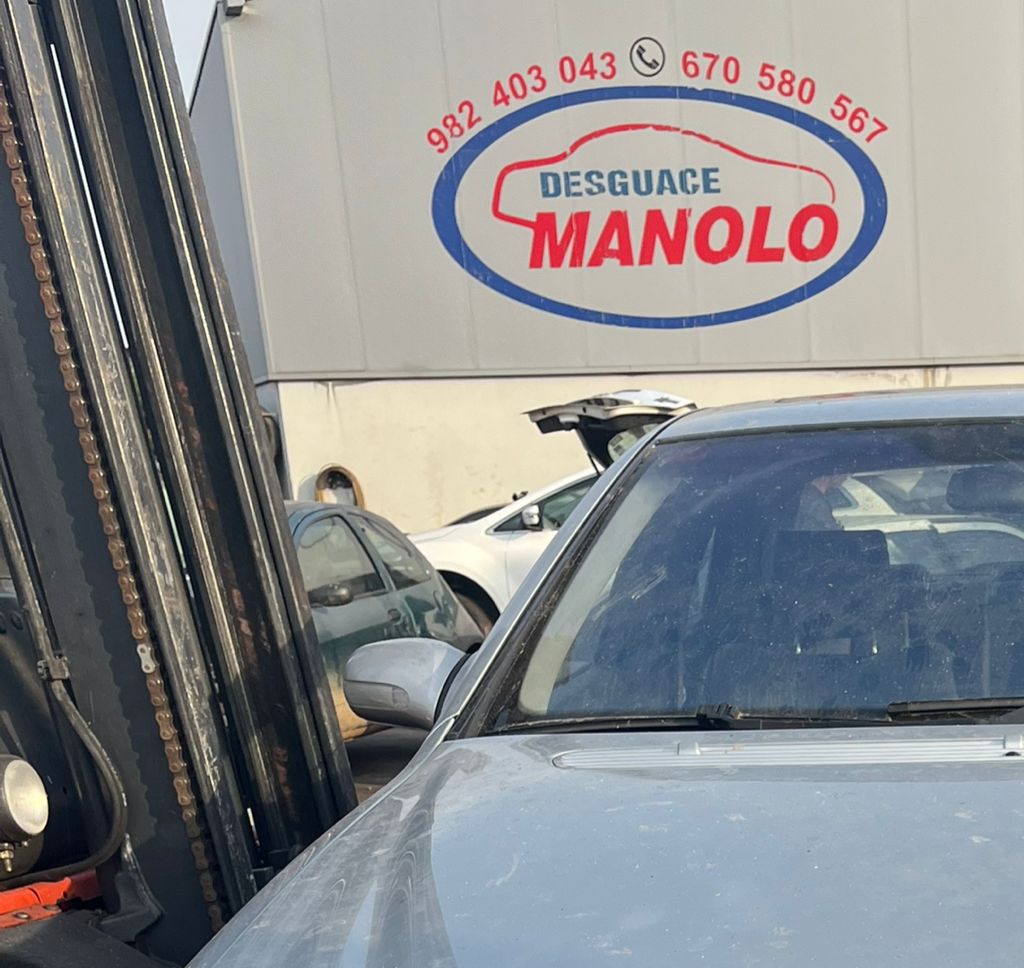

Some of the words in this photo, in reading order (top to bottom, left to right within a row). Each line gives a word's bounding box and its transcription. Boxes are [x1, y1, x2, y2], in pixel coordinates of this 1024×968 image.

[427, 99, 483, 155] 982
[492, 64, 548, 108] 403
[558, 51, 618, 84] 043
[681, 50, 741, 84] 670
[757, 62, 817, 106] 580
[829, 93, 889, 145] 567
[539, 167, 722, 199] DESGUACE
[528, 203, 839, 269] MANOLO
